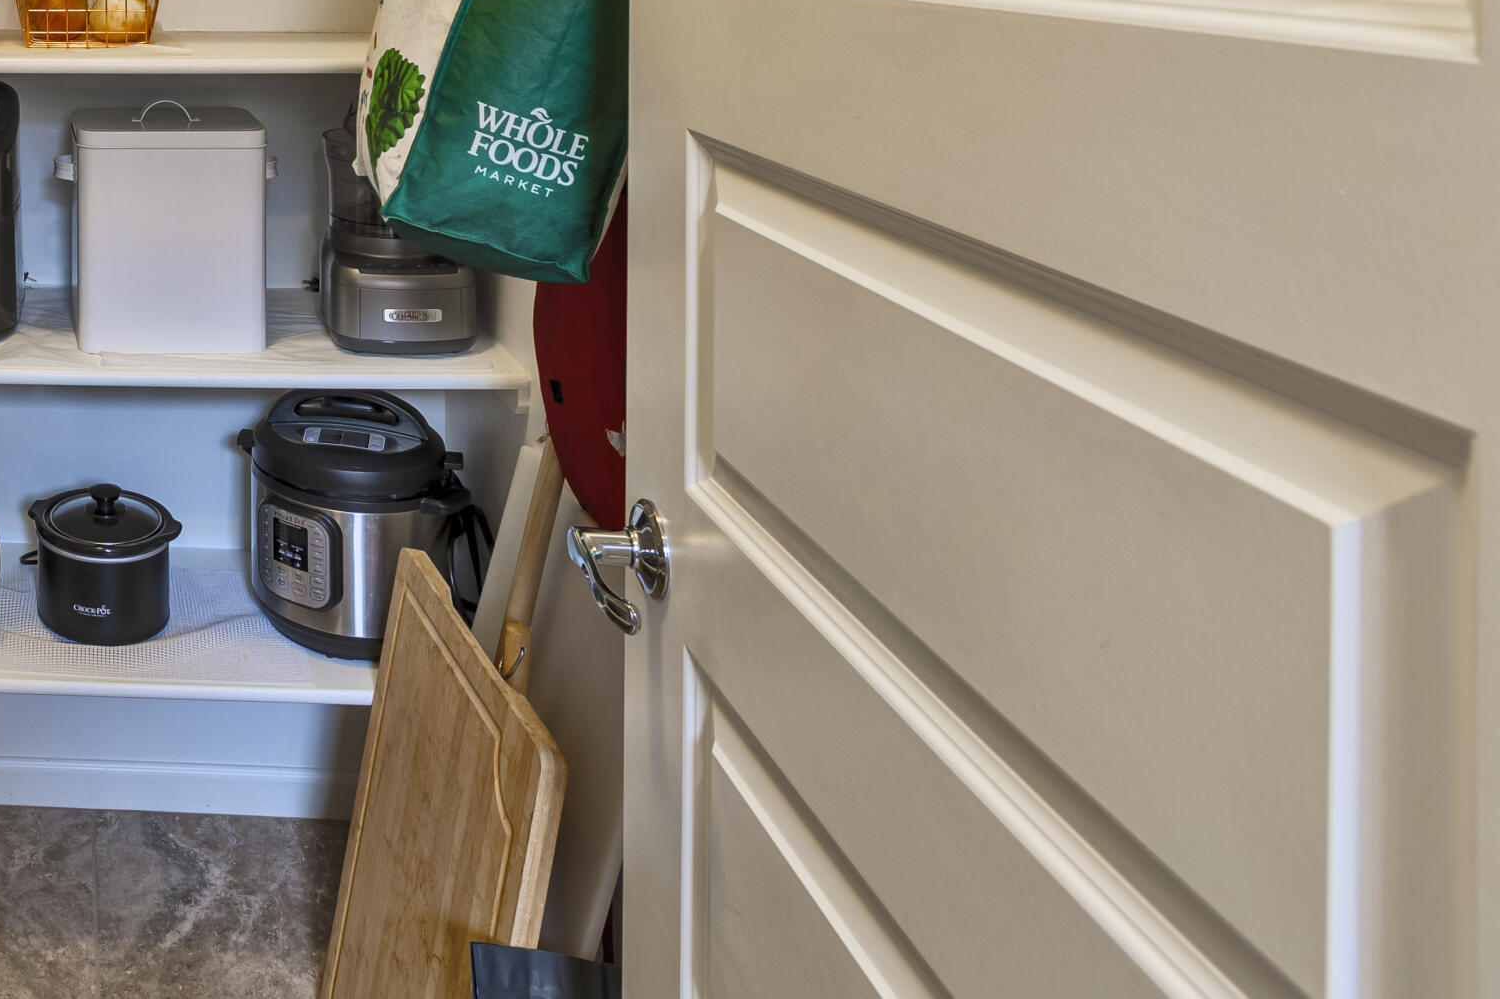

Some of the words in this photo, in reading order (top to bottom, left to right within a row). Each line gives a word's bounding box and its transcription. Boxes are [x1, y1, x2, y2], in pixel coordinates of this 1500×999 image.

[467, 130, 578, 187] FOODS
[476, 100, 589, 161] WHOLE
[474, 164, 554, 198] MARKET
